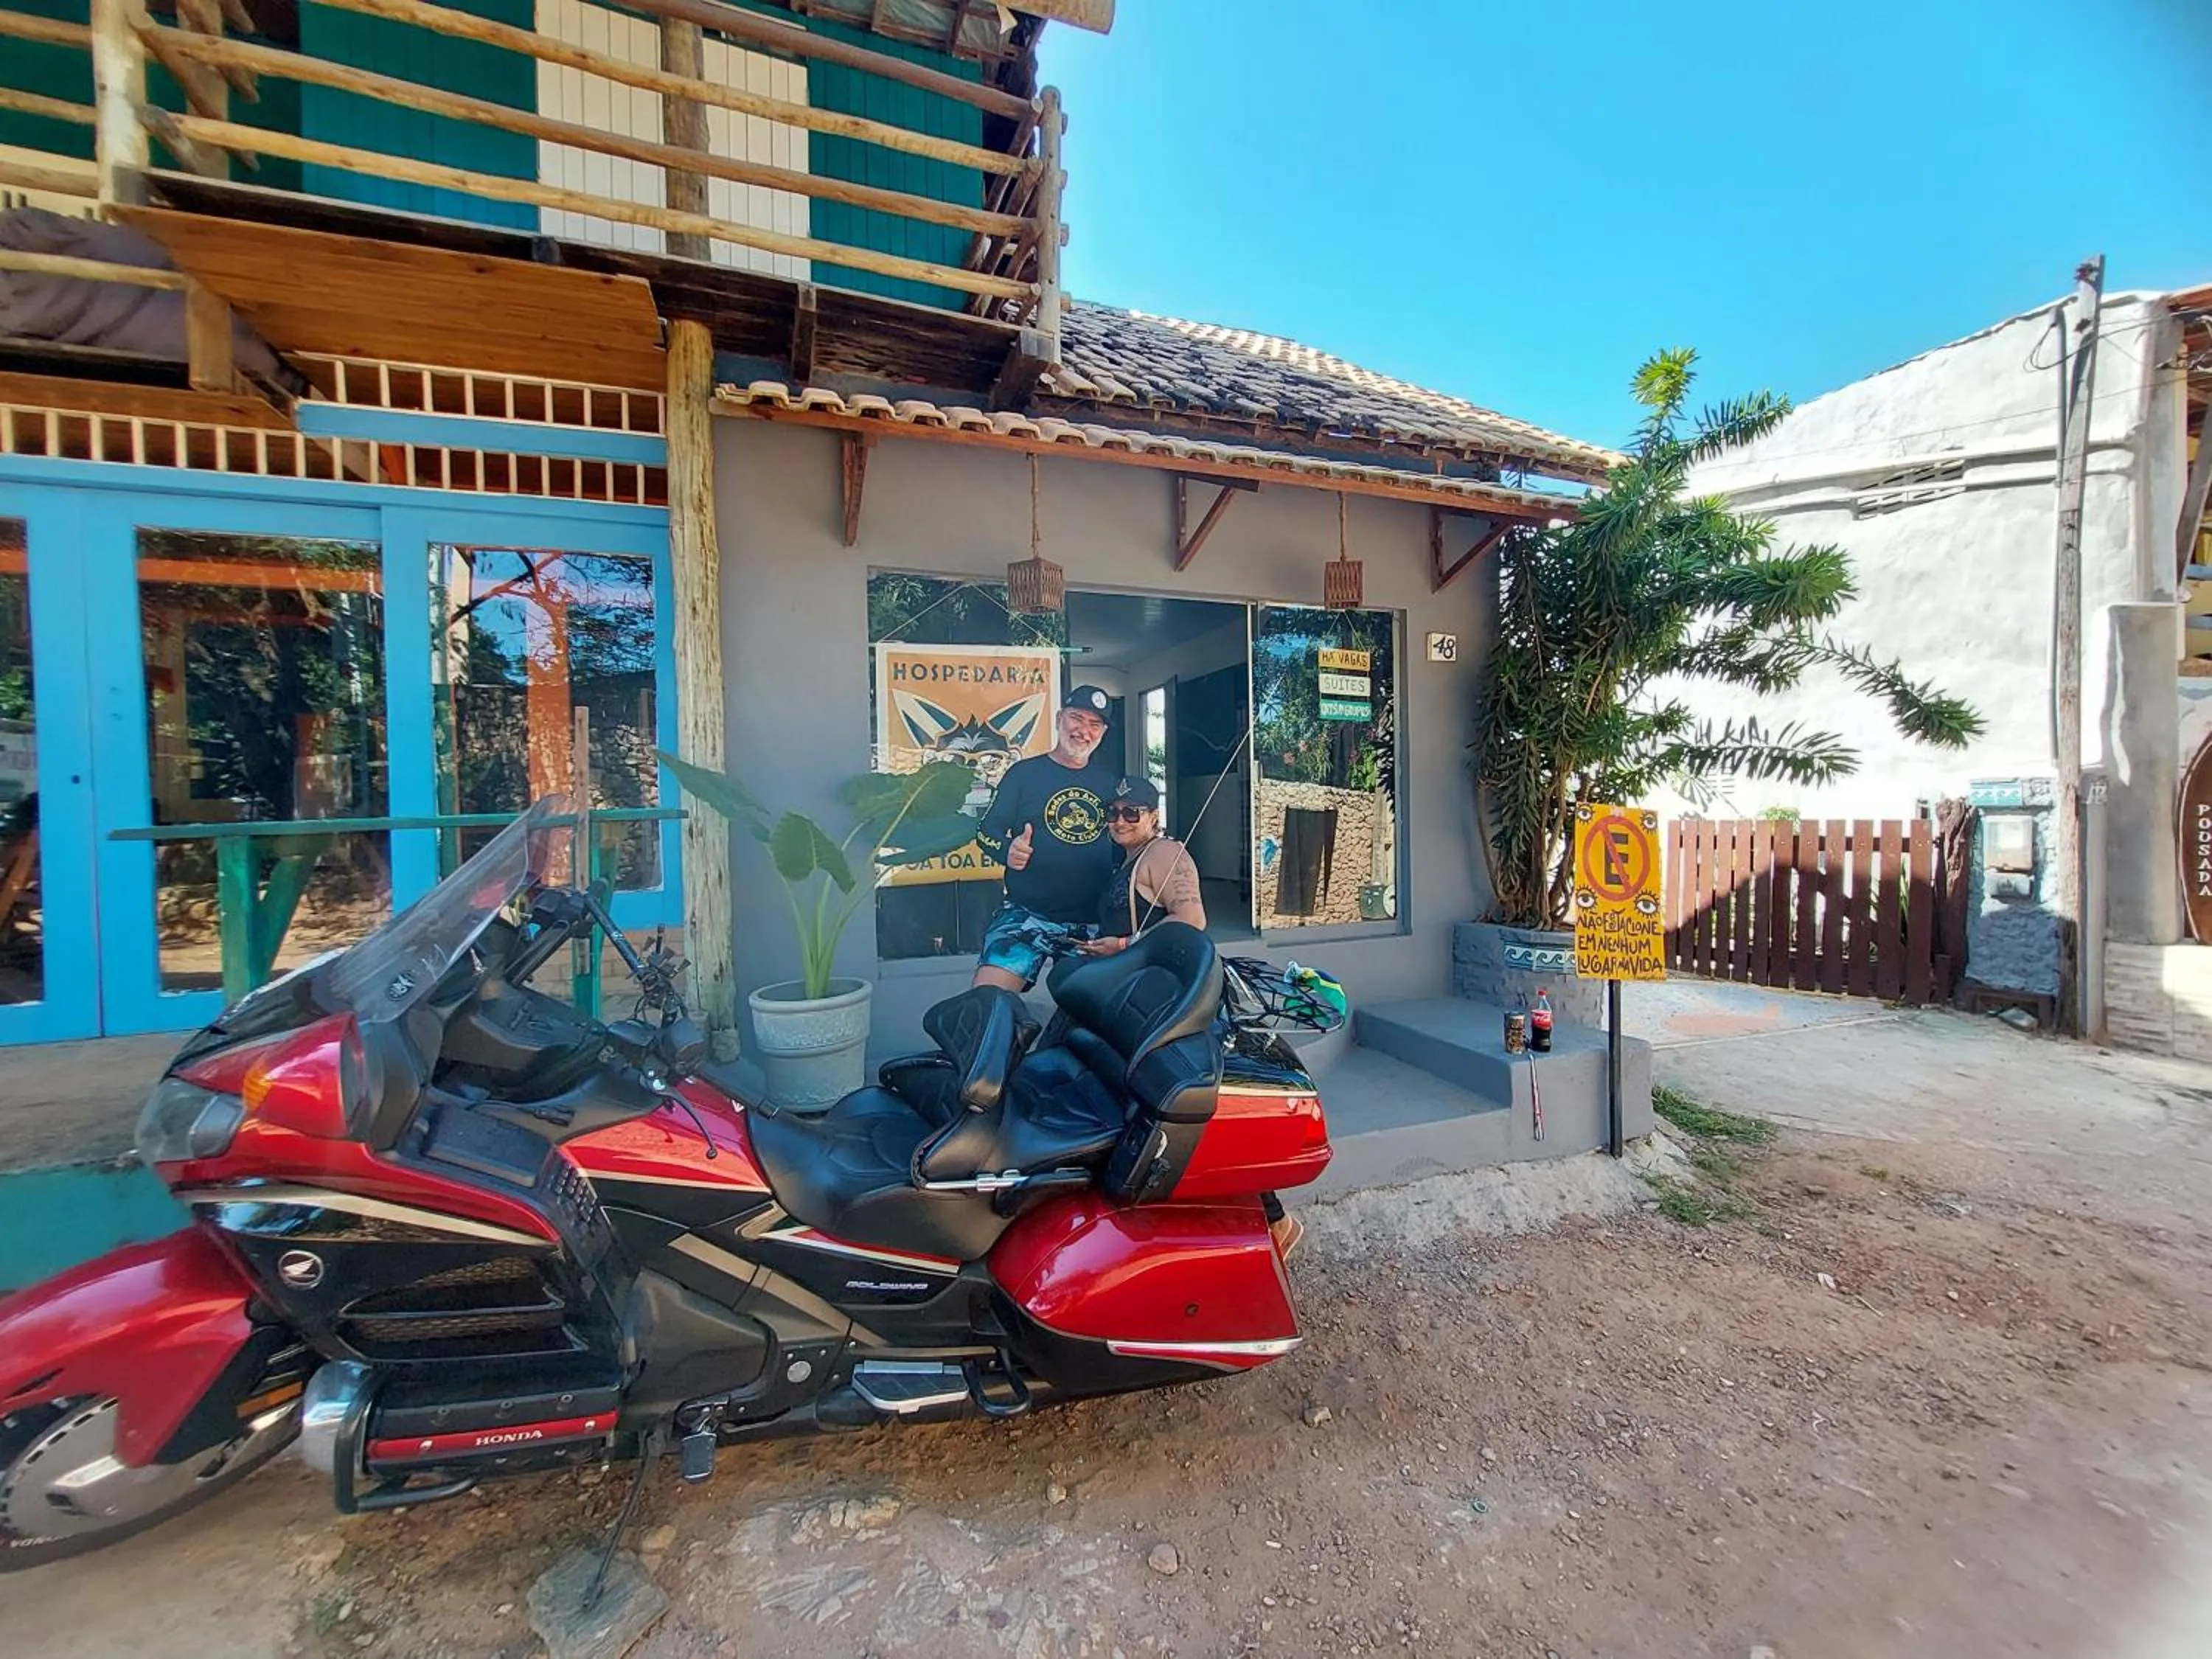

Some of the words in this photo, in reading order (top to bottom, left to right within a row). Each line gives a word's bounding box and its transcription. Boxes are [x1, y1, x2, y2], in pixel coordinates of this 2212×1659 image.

[1433, 636, 1455, 659] 48
[1338, 652, 1368, 667] VAGAS
[1054, 828, 1076, 841] Moto
[1604, 832, 1629, 886] E
[1576, 911, 1602, 930] NÃO
[1579, 933, 1596, 951] EM
[1597, 934, 1652, 956] NENHUM
[1578, 954, 1618, 977] LUGAR
[1630, 956, 1663, 975] VIDA
[475, 1430, 543, 1446] HONDA
